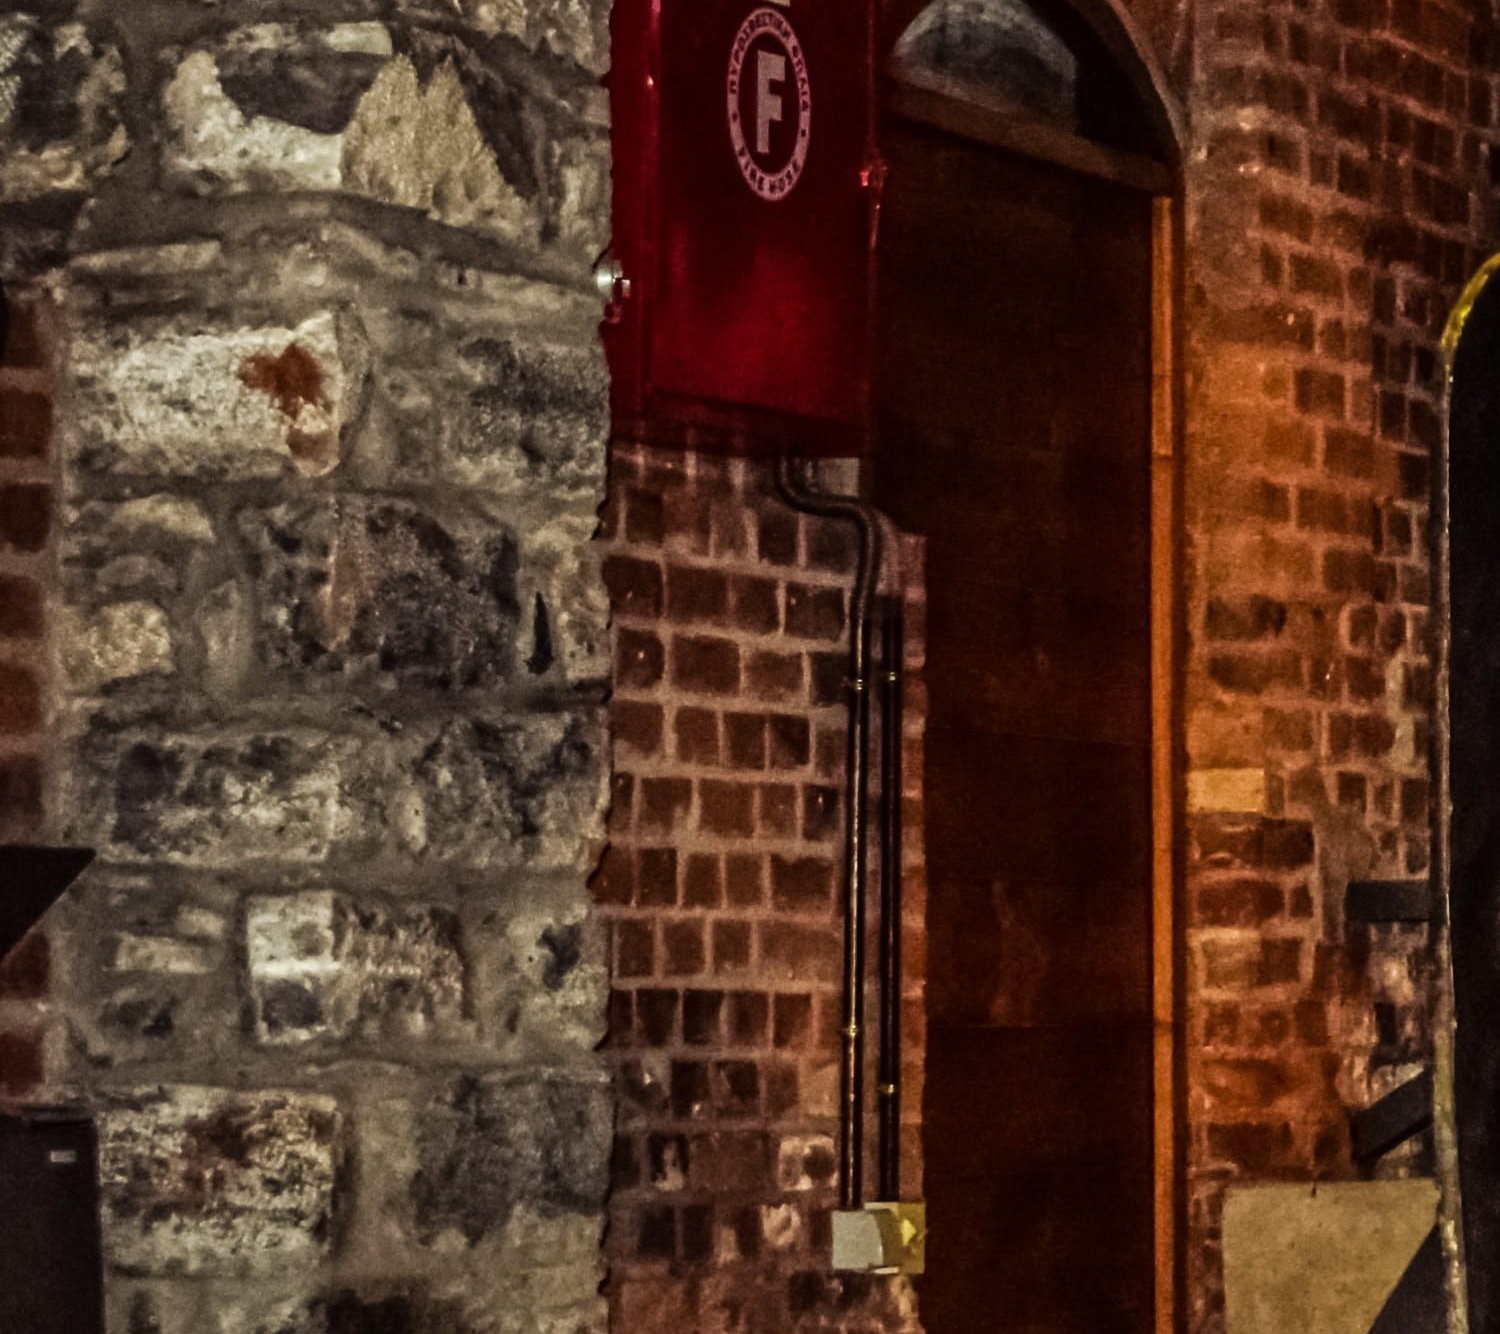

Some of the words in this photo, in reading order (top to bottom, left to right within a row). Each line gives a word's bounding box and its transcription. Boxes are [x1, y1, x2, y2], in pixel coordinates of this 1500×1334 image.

[757, 50, 786, 154] F
[738, 146, 765, 192] FIRE
[769, 158, 799, 195] HOSE
